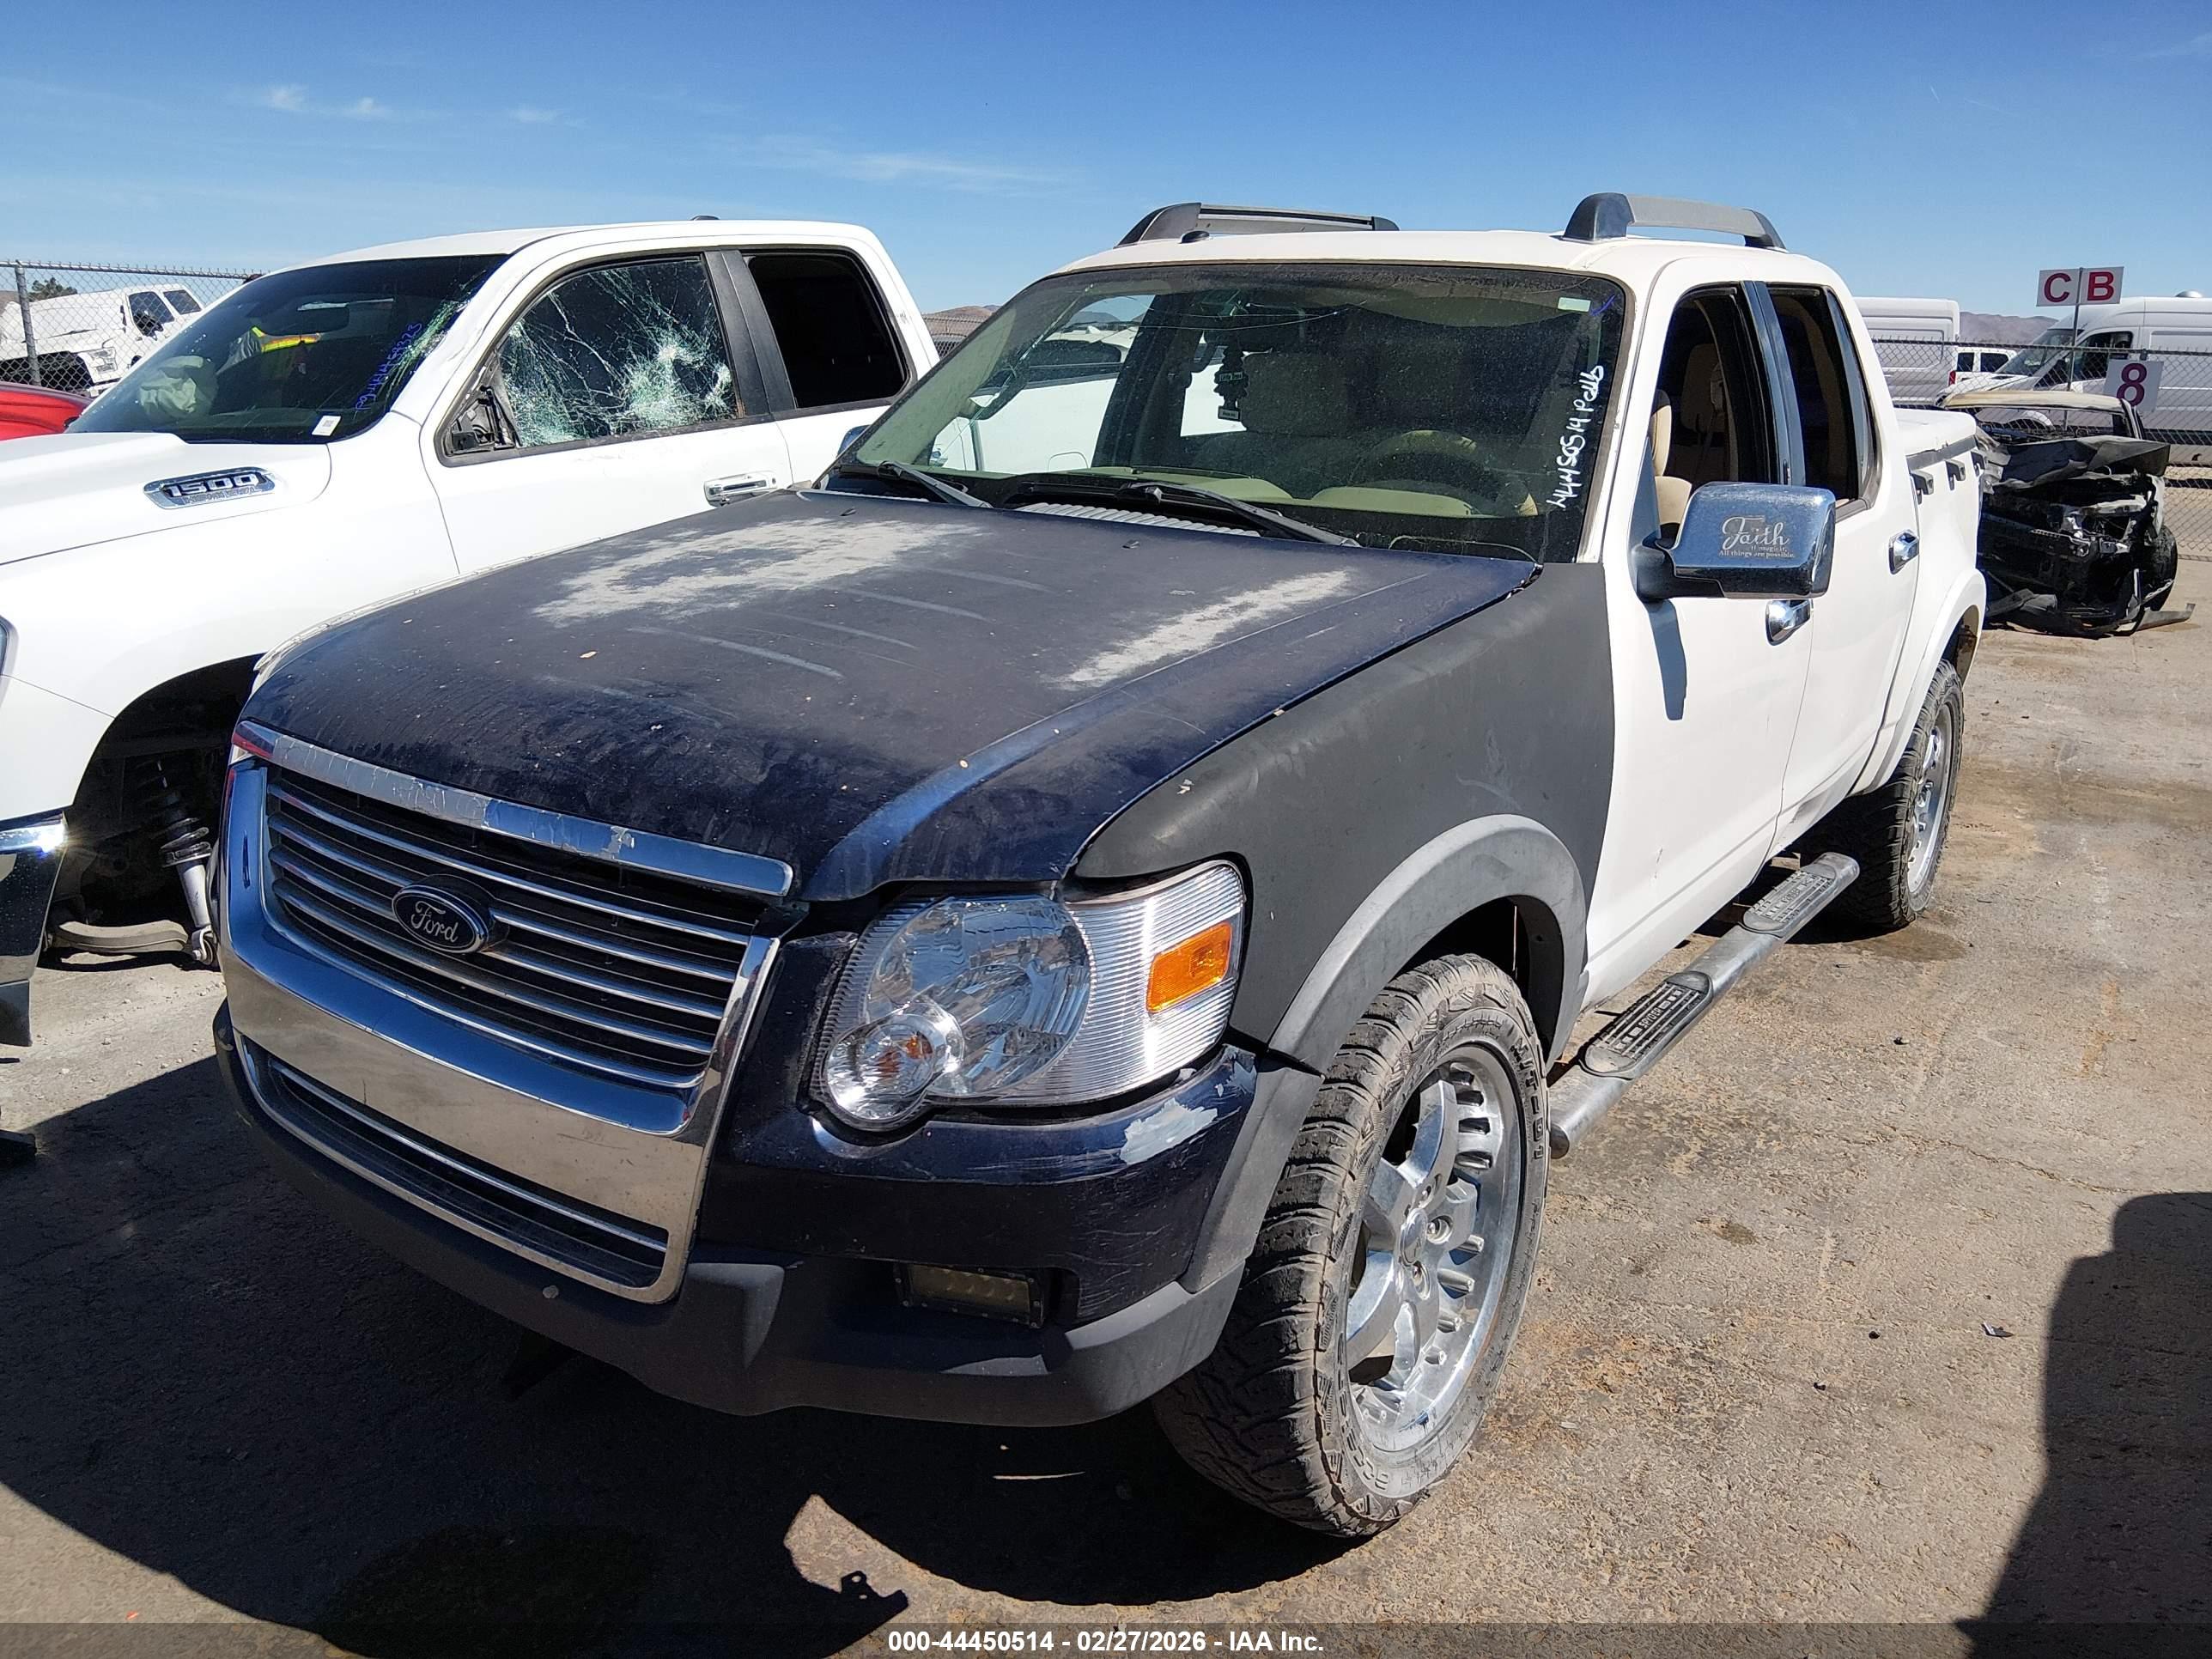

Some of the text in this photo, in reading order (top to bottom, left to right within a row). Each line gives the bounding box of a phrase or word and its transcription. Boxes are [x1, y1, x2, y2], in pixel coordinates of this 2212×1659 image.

[2044, 272, 2072, 303] C
[2087, 271, 2114, 301] B
[2116, 362, 2148, 407] 8
[168, 474, 258, 497] 1500
[1722, 516, 1790, 550] Faith
[410, 901, 459, 943] Ford
[1638, 1007, 1664, 1029] SPYDER
